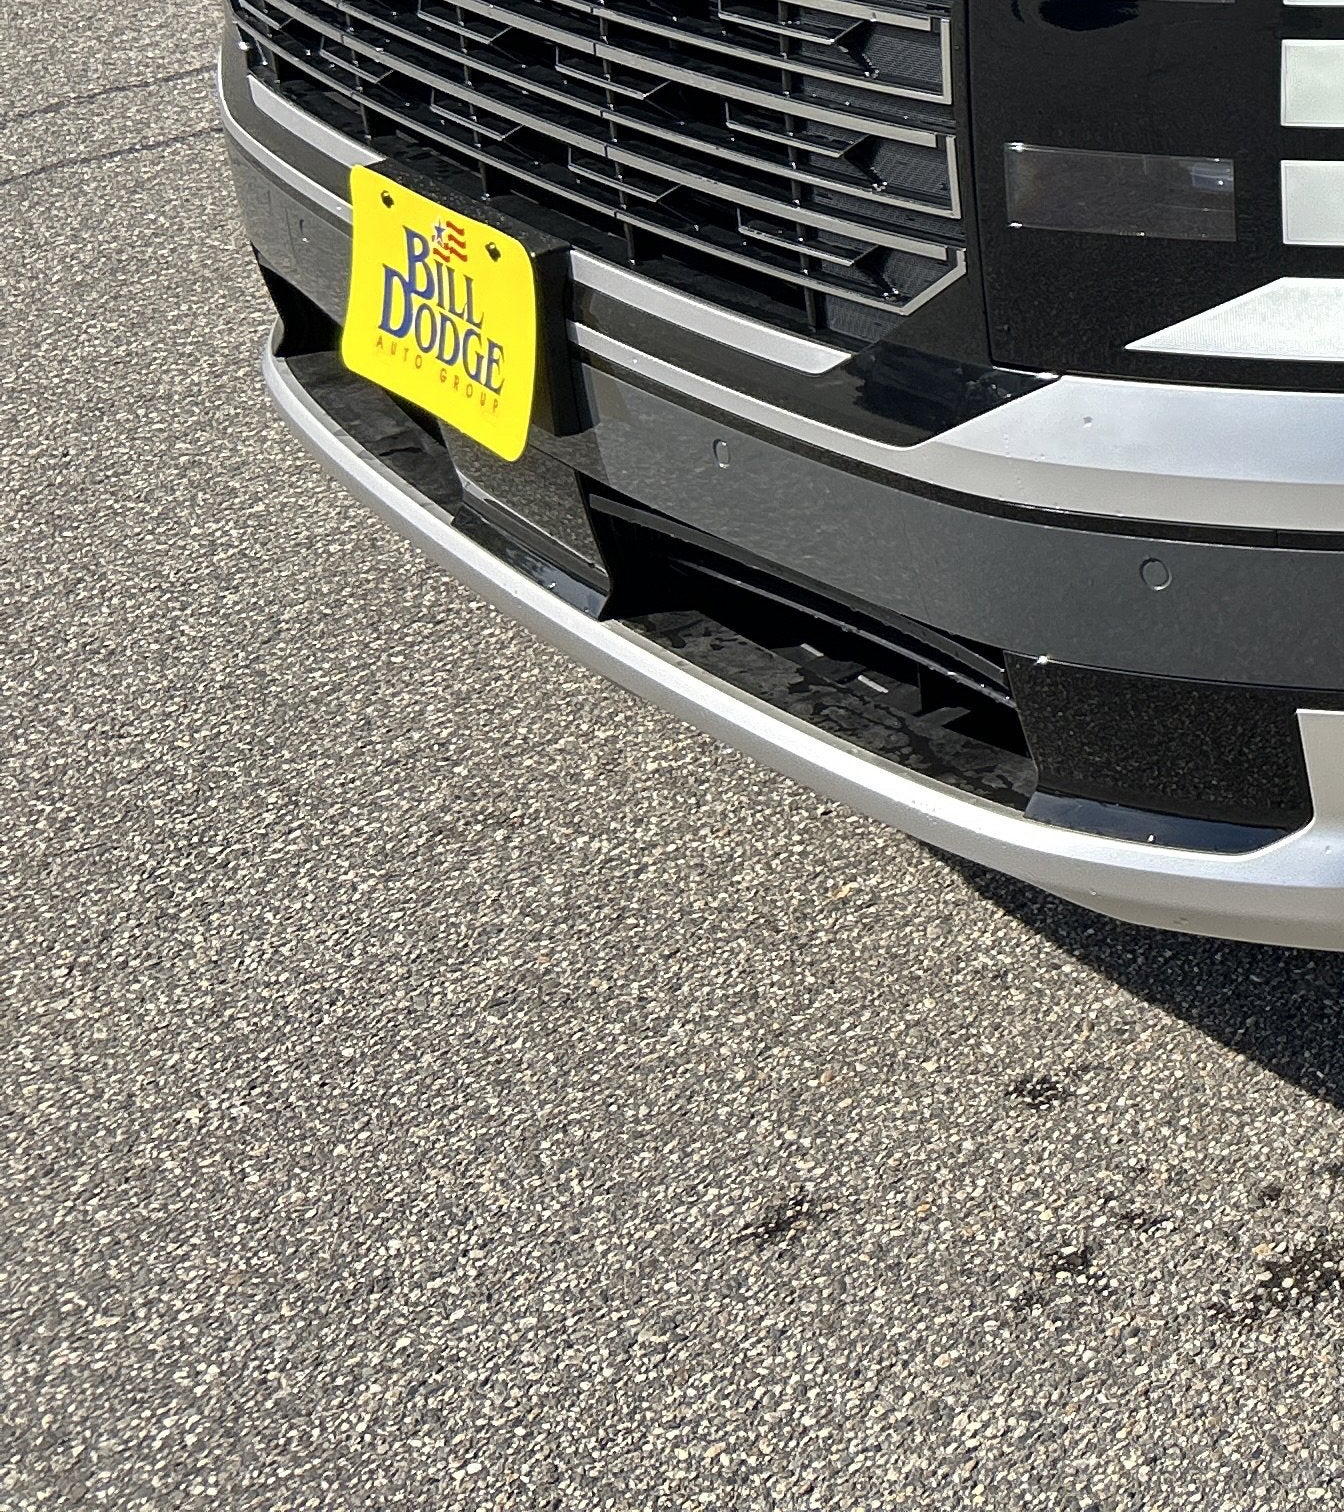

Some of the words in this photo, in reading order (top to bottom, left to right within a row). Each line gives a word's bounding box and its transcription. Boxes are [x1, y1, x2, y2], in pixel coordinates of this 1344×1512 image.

[377, 262, 505, 396] DODGE
[402, 224, 485, 330] BILL
[375, 334, 423, 370] AUTO
[439, 367, 499, 414] GROUP
